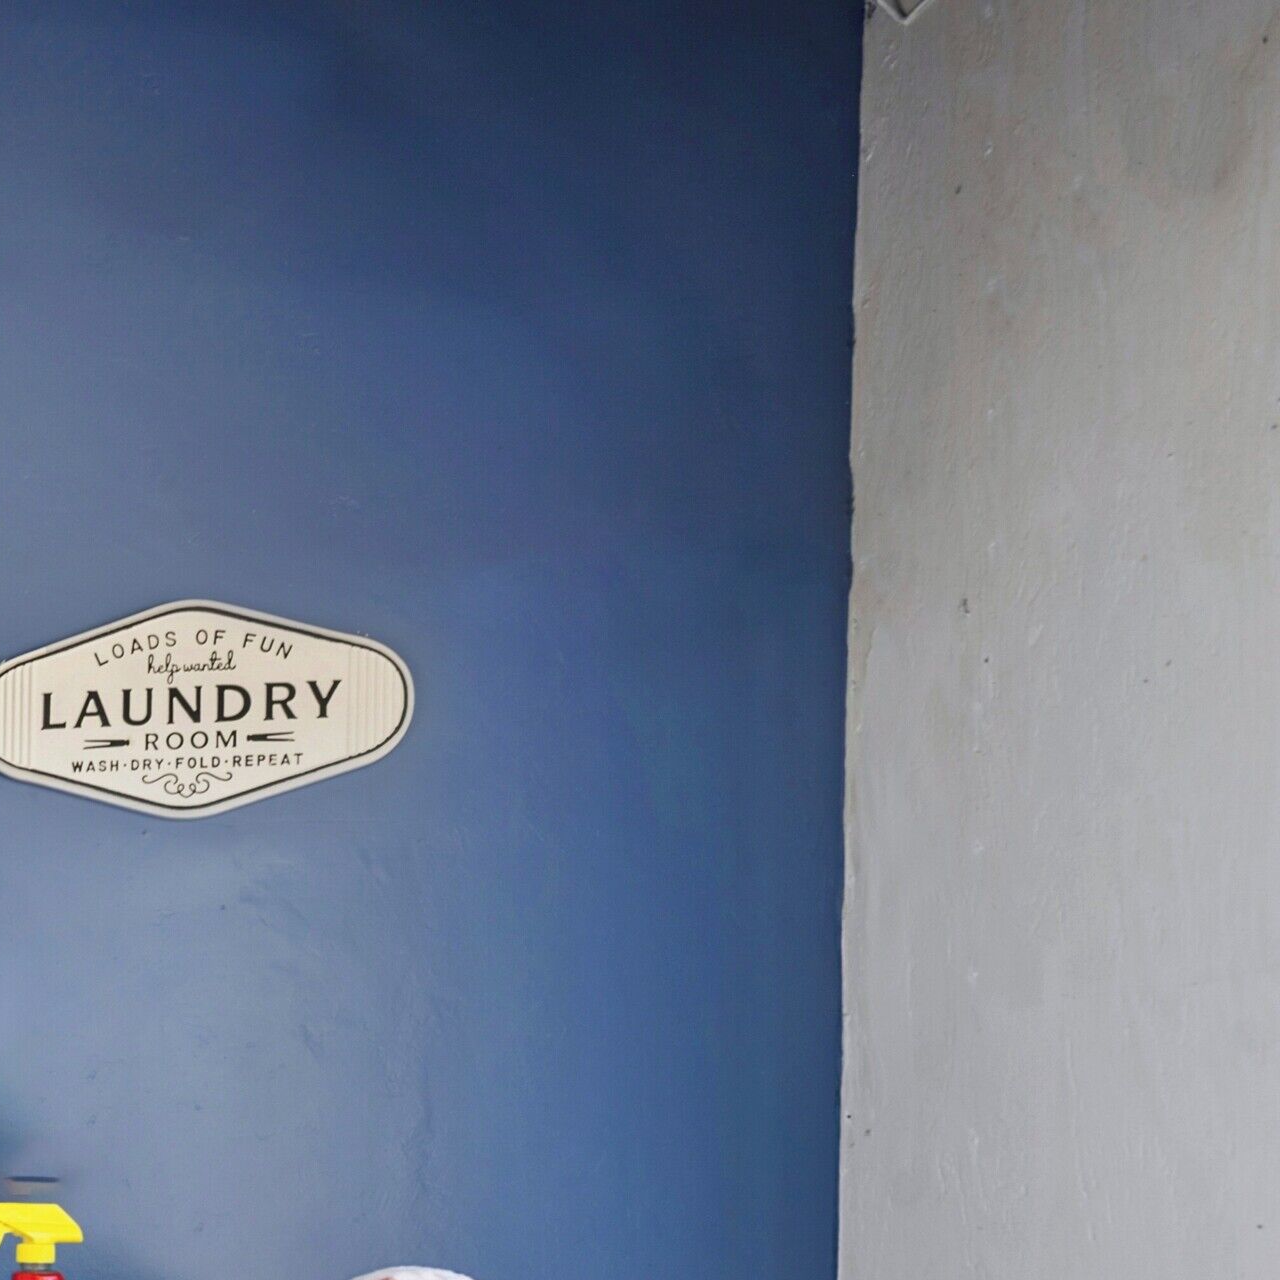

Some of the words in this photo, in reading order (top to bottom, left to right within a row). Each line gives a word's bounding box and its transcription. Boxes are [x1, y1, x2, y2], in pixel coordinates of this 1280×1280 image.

[94, 631, 178, 666] LOADS
[195, 629, 226, 645] OF
[242, 633, 294, 660] FUN
[147, 653, 181, 684] help
[182, 650, 237, 672] wanted
[40, 679, 343, 731] LAUNDRY
[145, 730, 237, 750] ROOM
